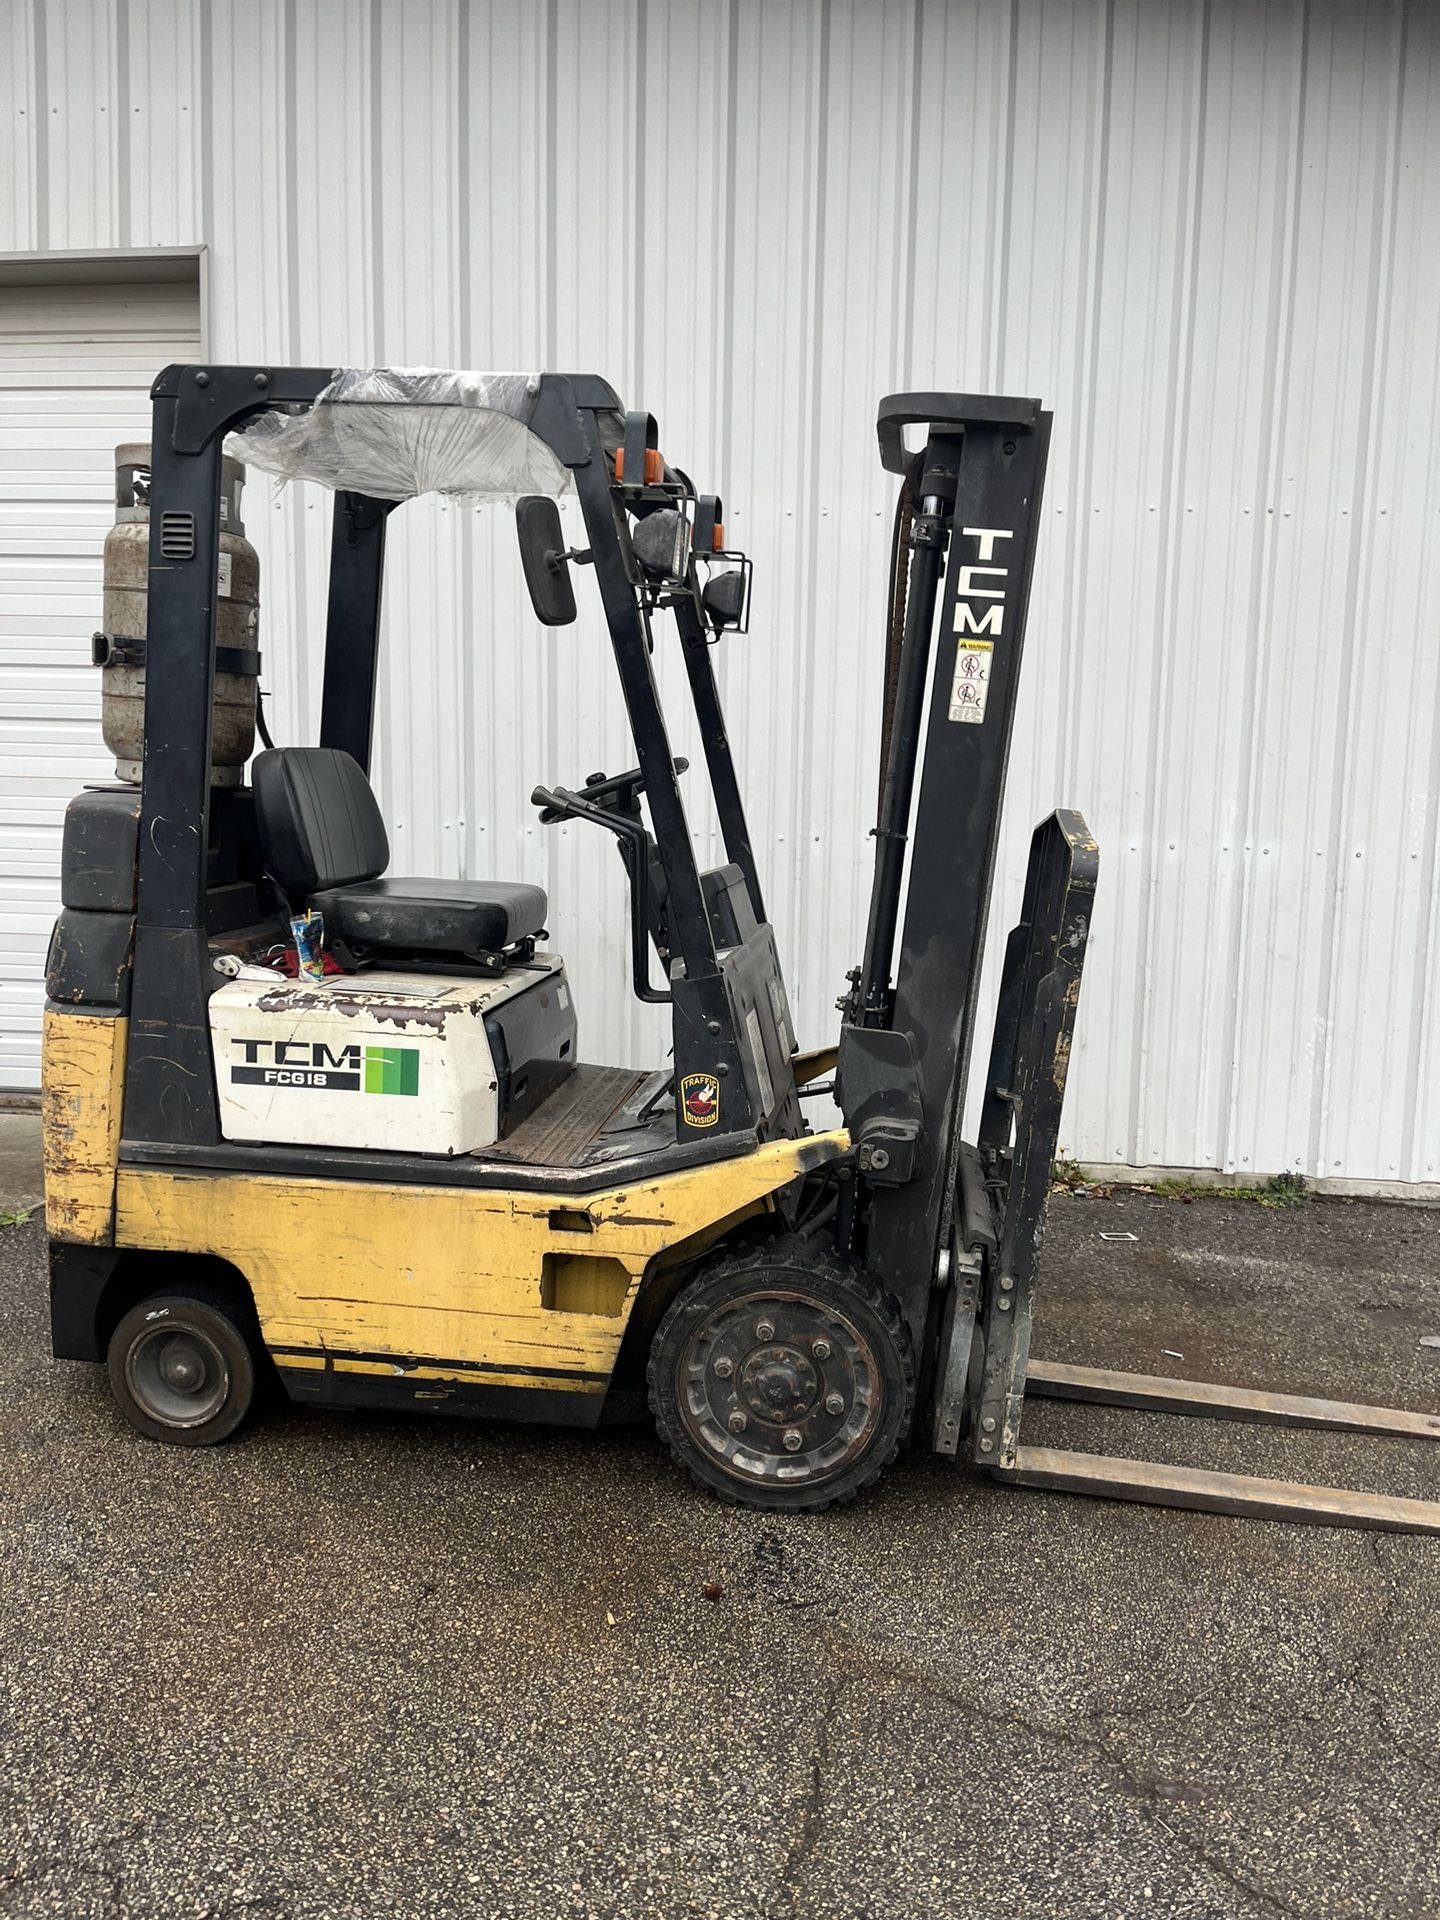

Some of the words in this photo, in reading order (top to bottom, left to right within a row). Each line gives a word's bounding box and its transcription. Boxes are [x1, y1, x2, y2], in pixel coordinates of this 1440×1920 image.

[953, 527, 1013, 635] TCM
[231, 1039, 361, 1069] TCM
[264, 1071, 327, 1086] FCG18
[684, 1077, 717, 1089] TRAFFIC
[687, 1111, 716, 1124] DIVISION
